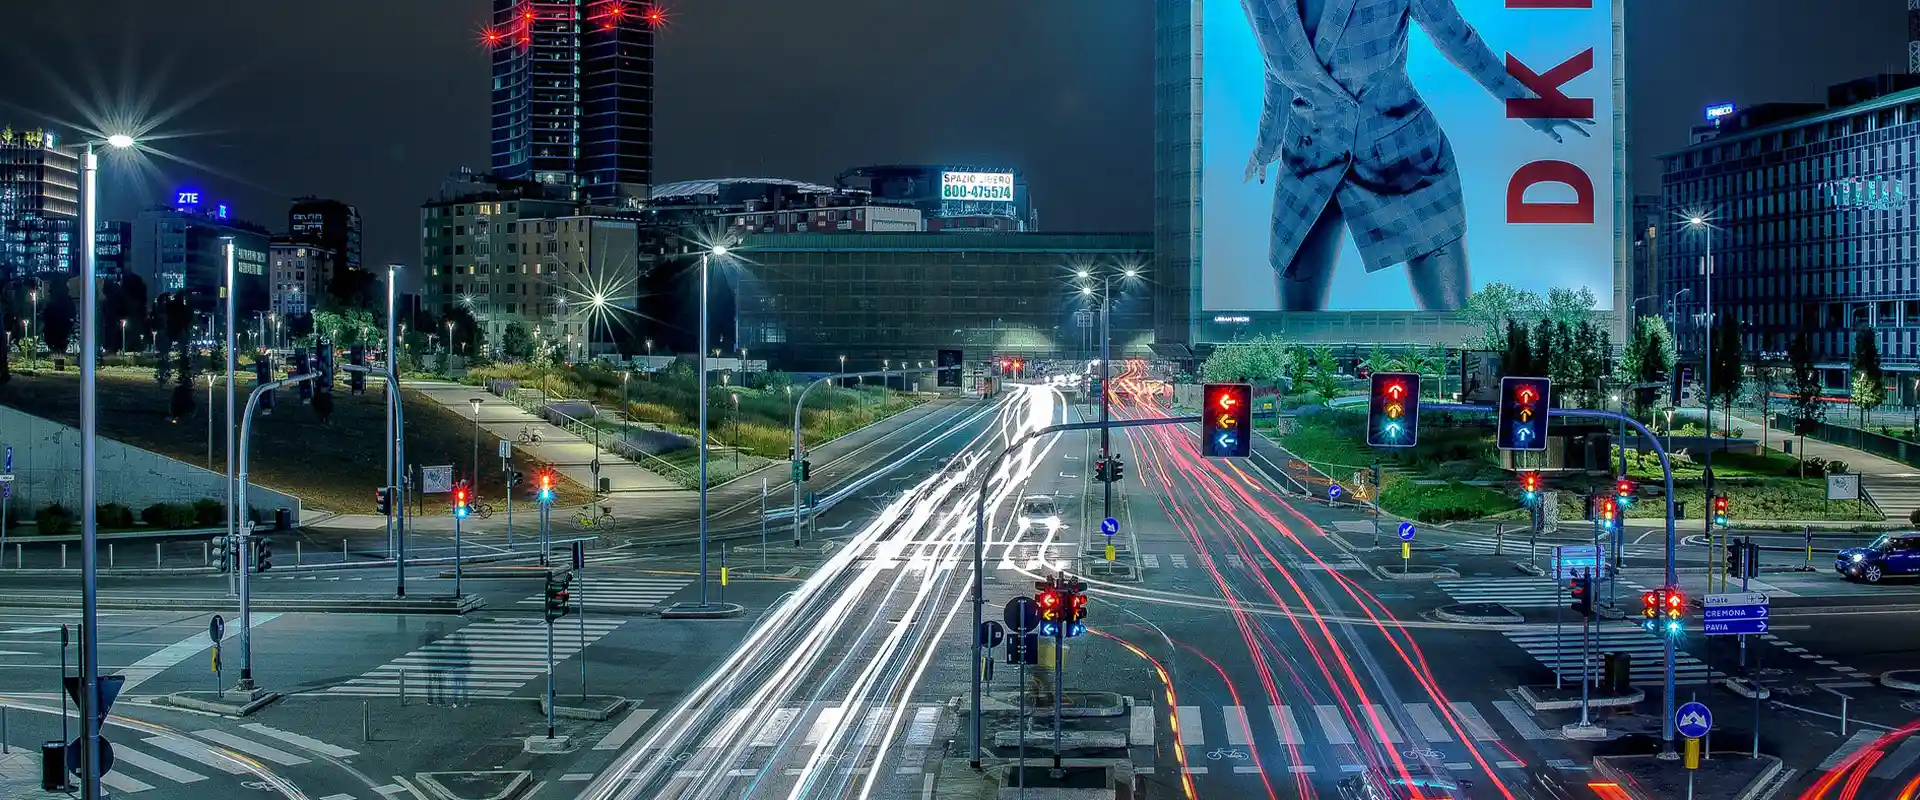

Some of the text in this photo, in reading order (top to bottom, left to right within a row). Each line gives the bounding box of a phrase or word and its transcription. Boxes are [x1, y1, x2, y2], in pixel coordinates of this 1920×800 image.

[1505, 0, 1595, 224] DK
[943, 173, 1011, 185] SPAZIO LIBERO
[943, 184, 1012, 199] 800-475574
[178, 192, 199, 204] ZTE
[1705, 596, 1729, 604] Linate
[1705, 609, 1746, 617] CREMONA
[1705, 623, 1729, 631] PAVIA
